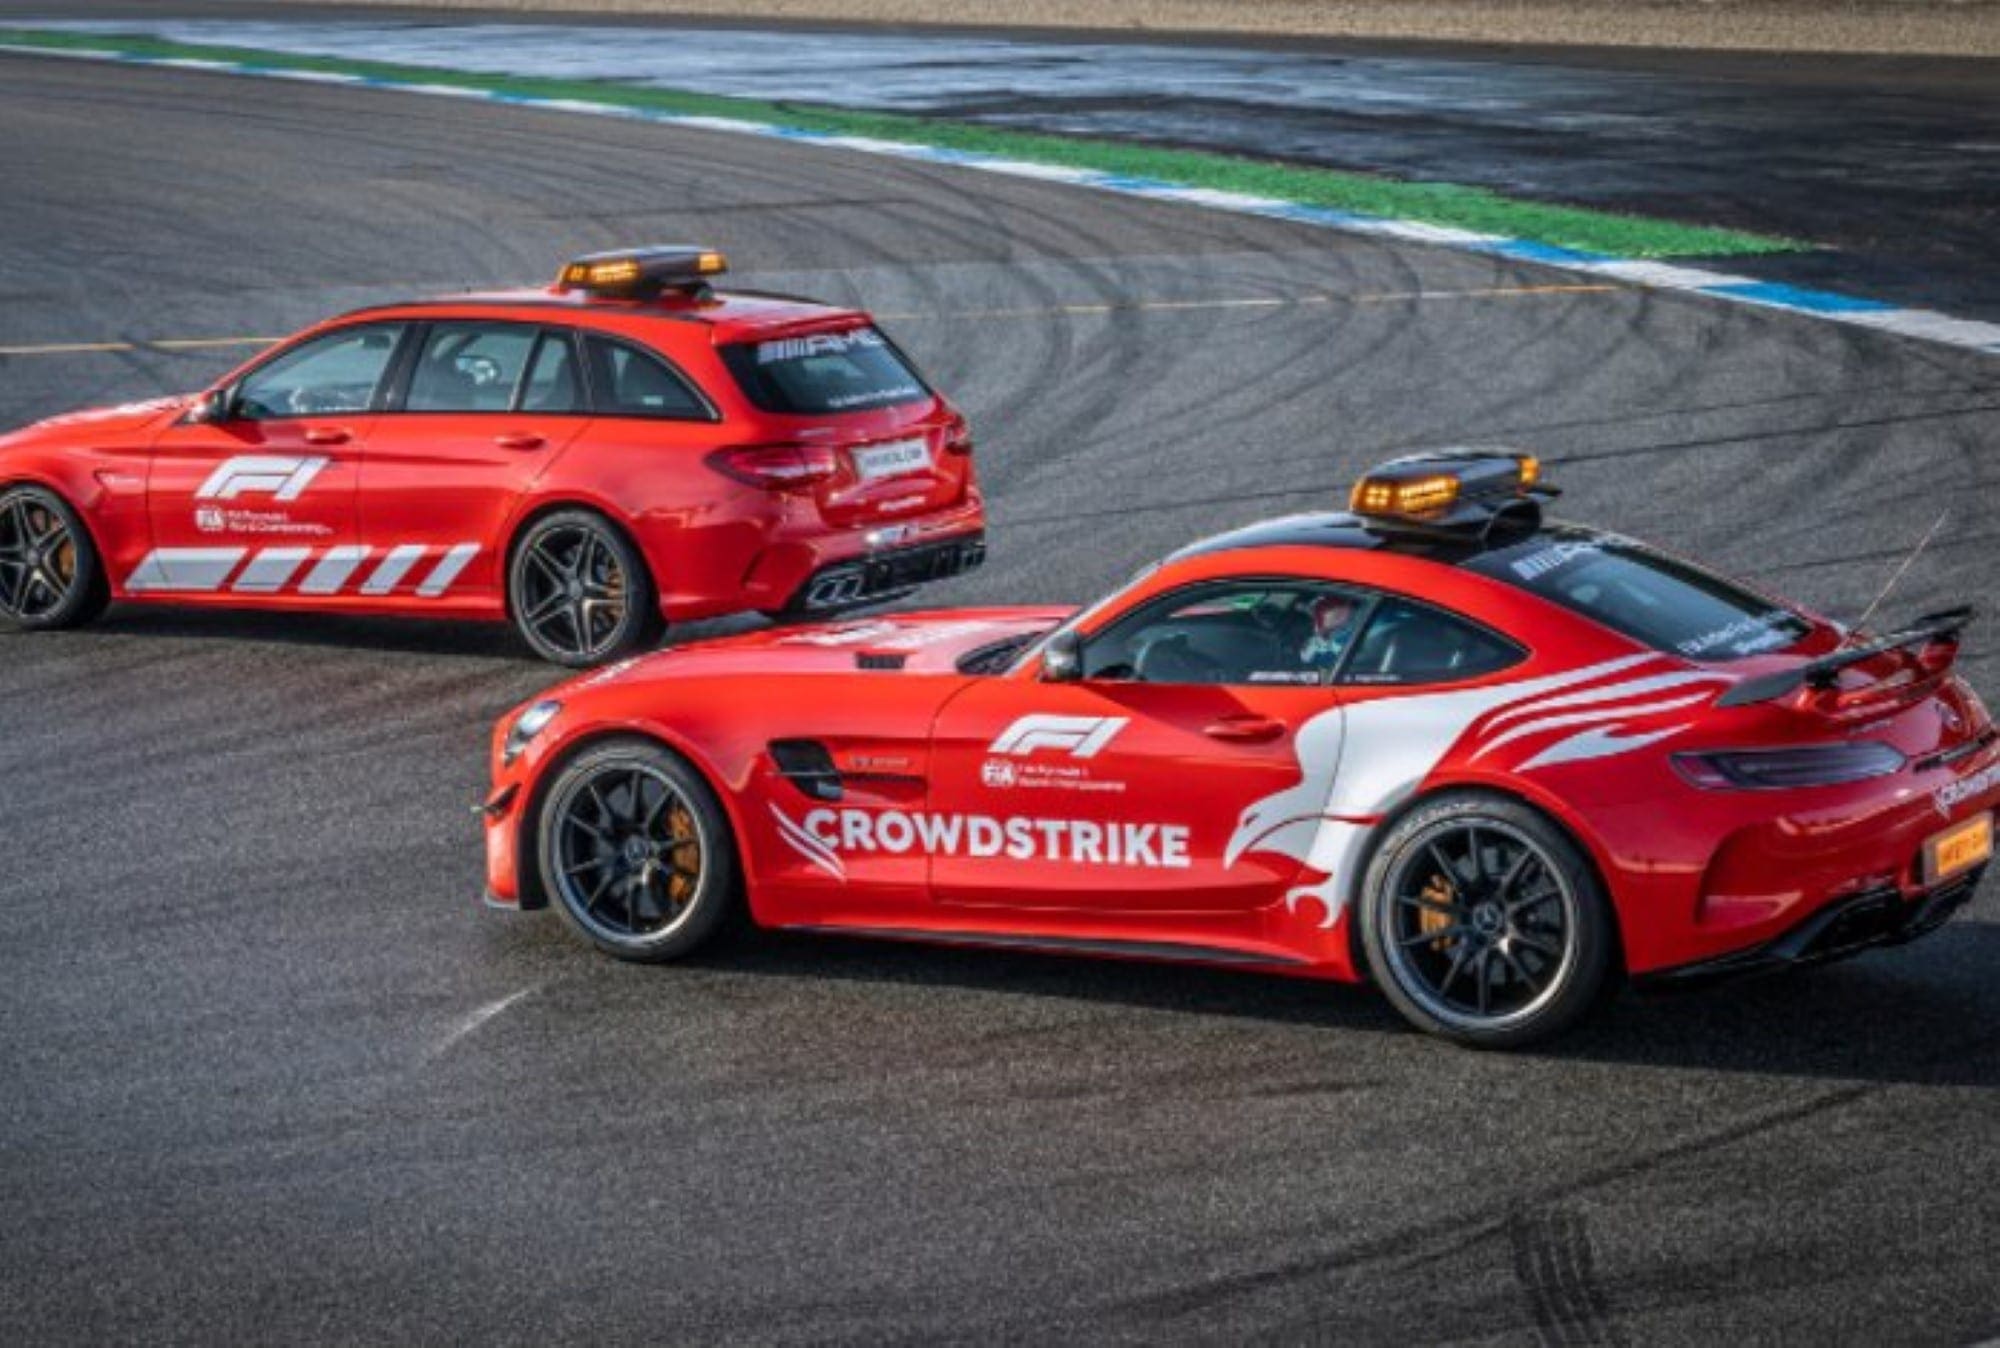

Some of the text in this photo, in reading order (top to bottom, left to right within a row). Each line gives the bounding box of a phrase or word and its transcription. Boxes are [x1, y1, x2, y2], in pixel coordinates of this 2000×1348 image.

[194, 455, 331, 501] F1
[987, 714, 1132, 758] F1
[803, 808, 1191, 868] CROWDSTRIKE
